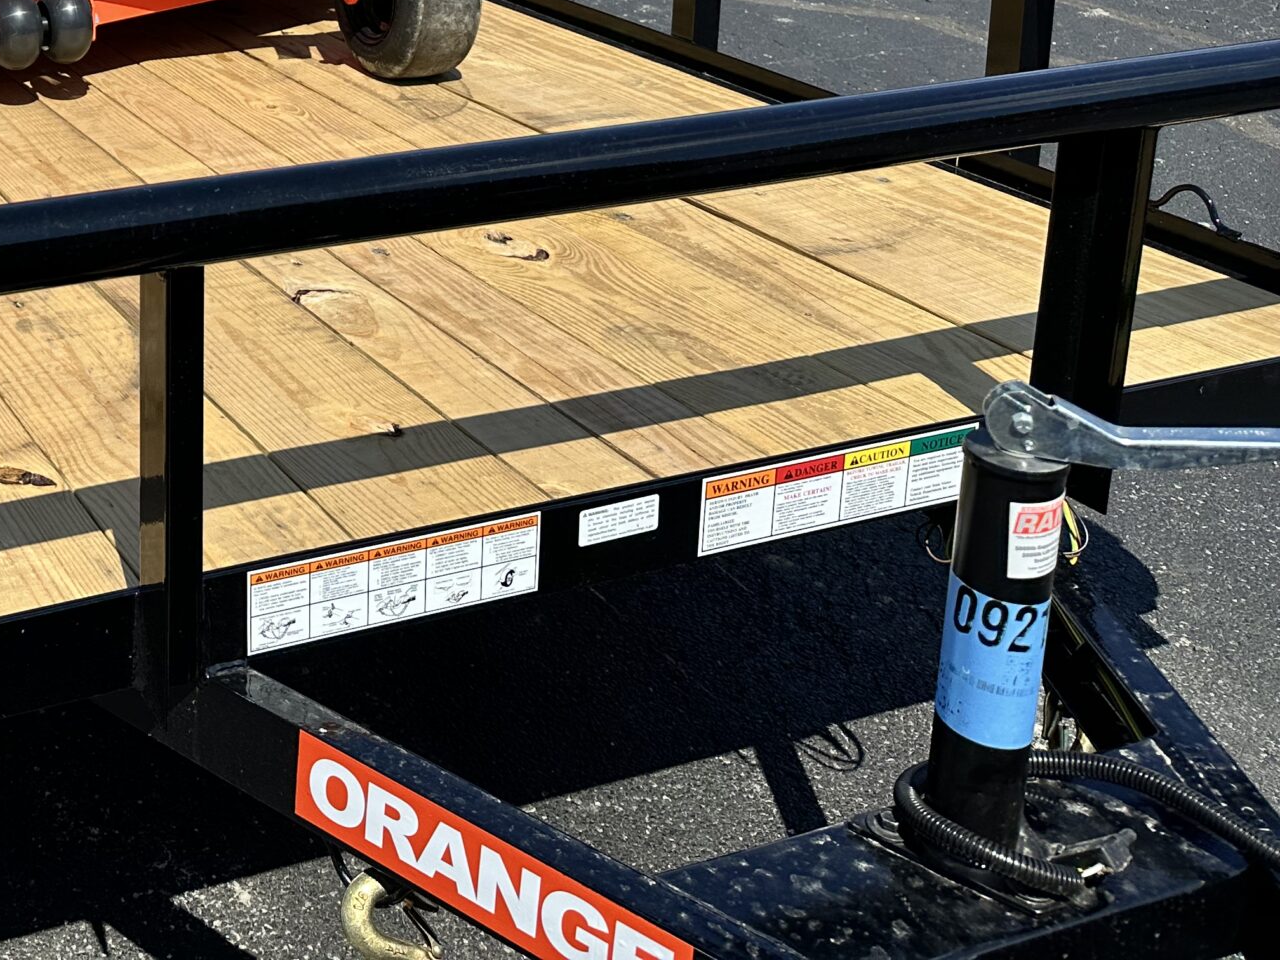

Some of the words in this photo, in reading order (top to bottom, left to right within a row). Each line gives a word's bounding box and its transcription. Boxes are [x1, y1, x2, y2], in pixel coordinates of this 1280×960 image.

[922, 434, 964, 450] NOTICE
[859, 447, 905, 464] CAUTION
[795, 460, 838, 478] DANGER
[712, 474, 770, 495] WARNING
[784, 491, 802, 500] MAKE
[497, 519, 535, 532] WARNING
[441, 530, 479, 544] WARNING
[384, 542, 422, 556] WARNING
[325, 554, 365, 568] WARNING
[265, 566, 306, 581] WARNING
